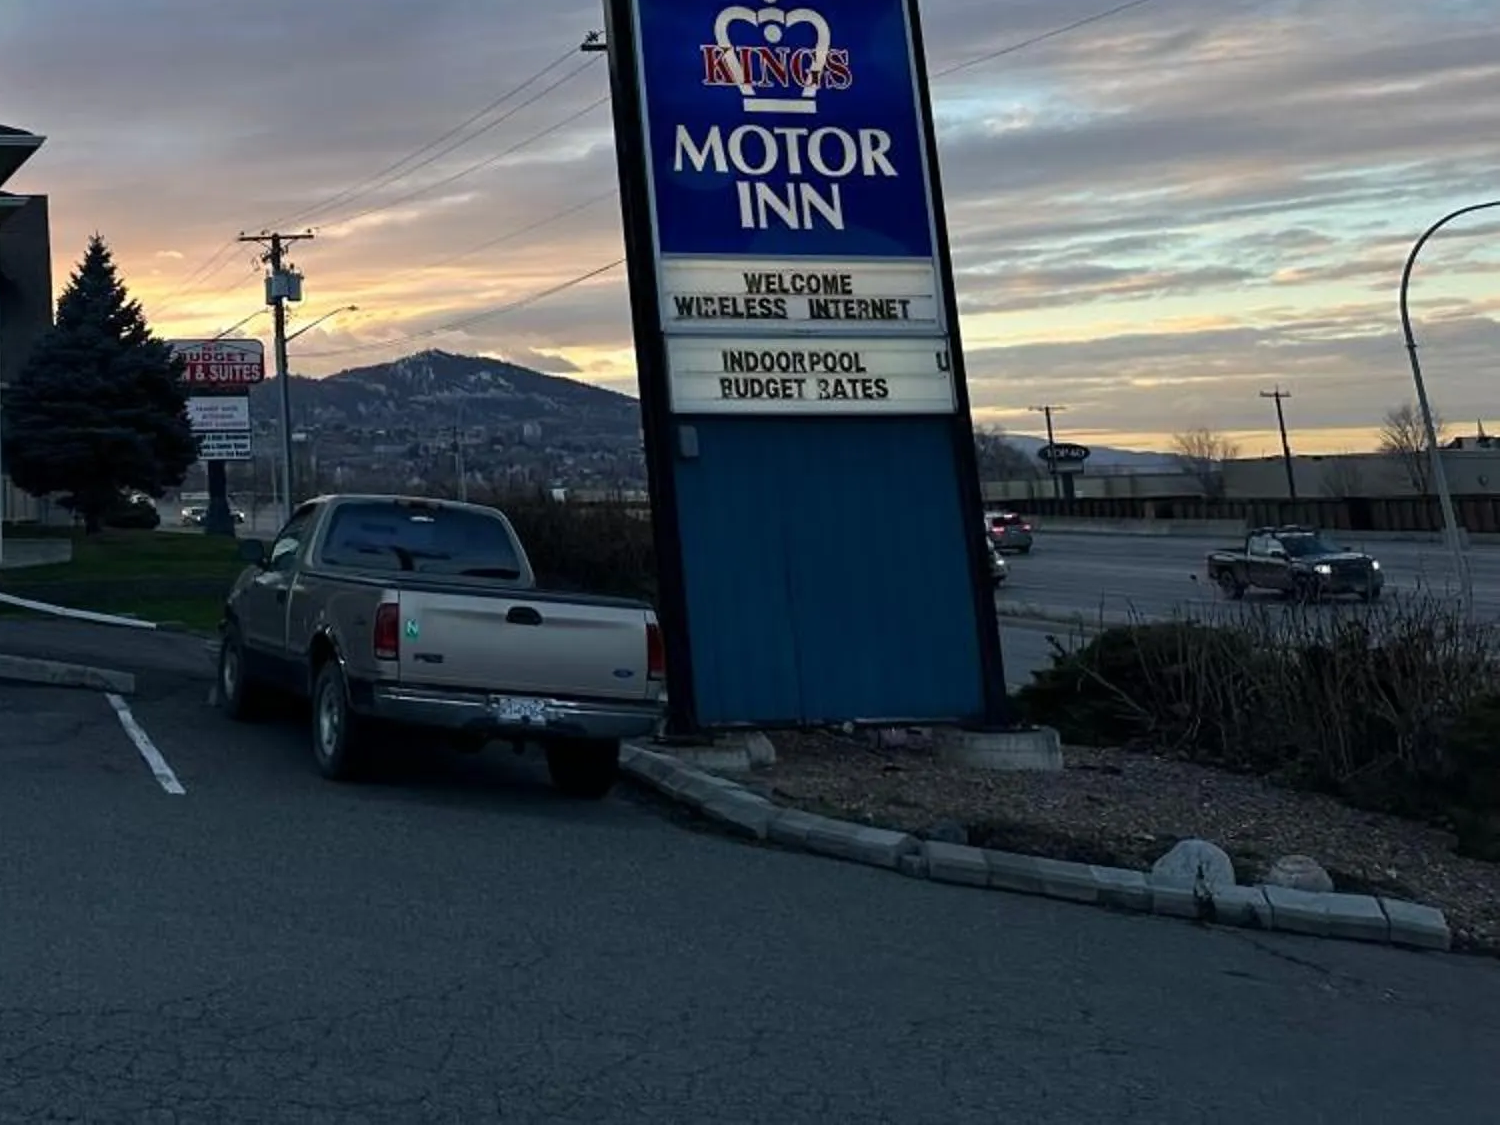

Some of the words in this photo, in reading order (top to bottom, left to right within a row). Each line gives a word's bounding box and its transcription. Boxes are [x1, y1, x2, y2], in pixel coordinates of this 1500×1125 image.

[700, 44, 852, 90] KINGS
[673, 124, 898, 177] MOTOR
[736, 180, 845, 230] INN
[743, 272, 853, 295] WELCOME
[674, 295, 789, 320] WIRELESS
[808, 298, 911, 320] INTERNET
[209, 363, 260, 382] SUITES
[719, 376, 806, 400] BUDGET
